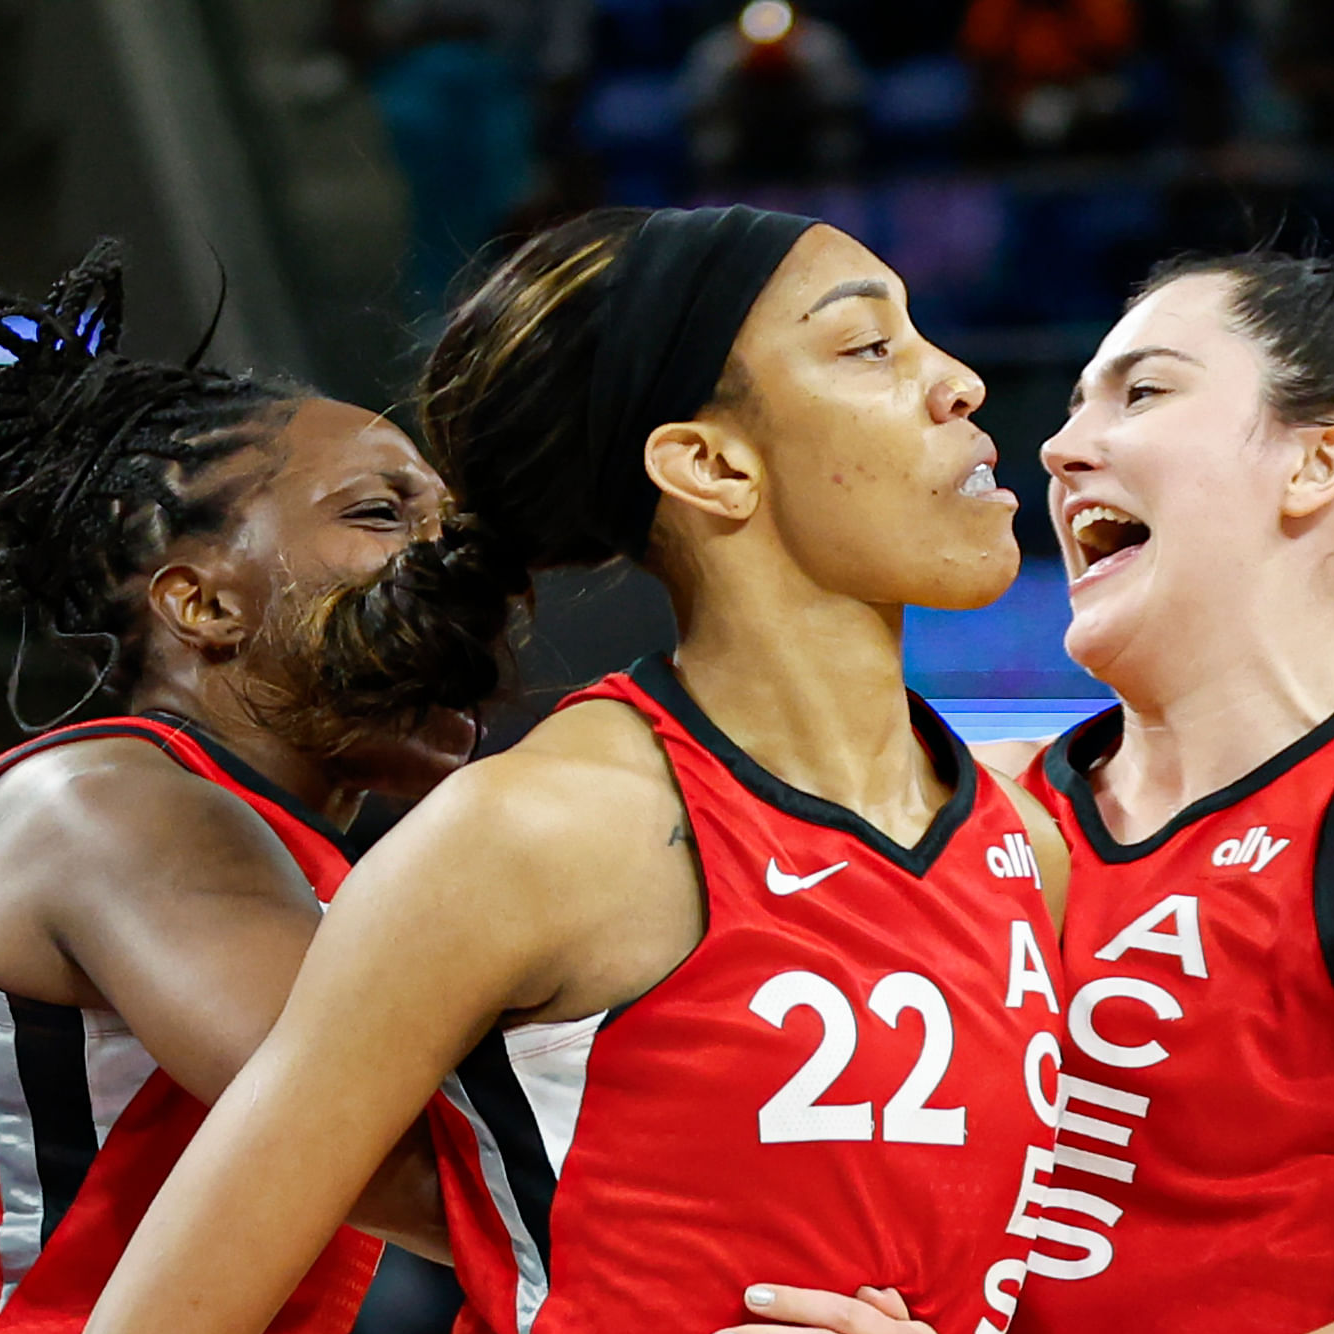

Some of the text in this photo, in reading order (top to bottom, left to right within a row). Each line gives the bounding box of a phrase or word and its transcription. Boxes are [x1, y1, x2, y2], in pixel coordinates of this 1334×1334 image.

[1211, 827, 1290, 873] ally
[748, 970, 967, 1145] 22
[1026, 894, 1209, 1281] ACES
